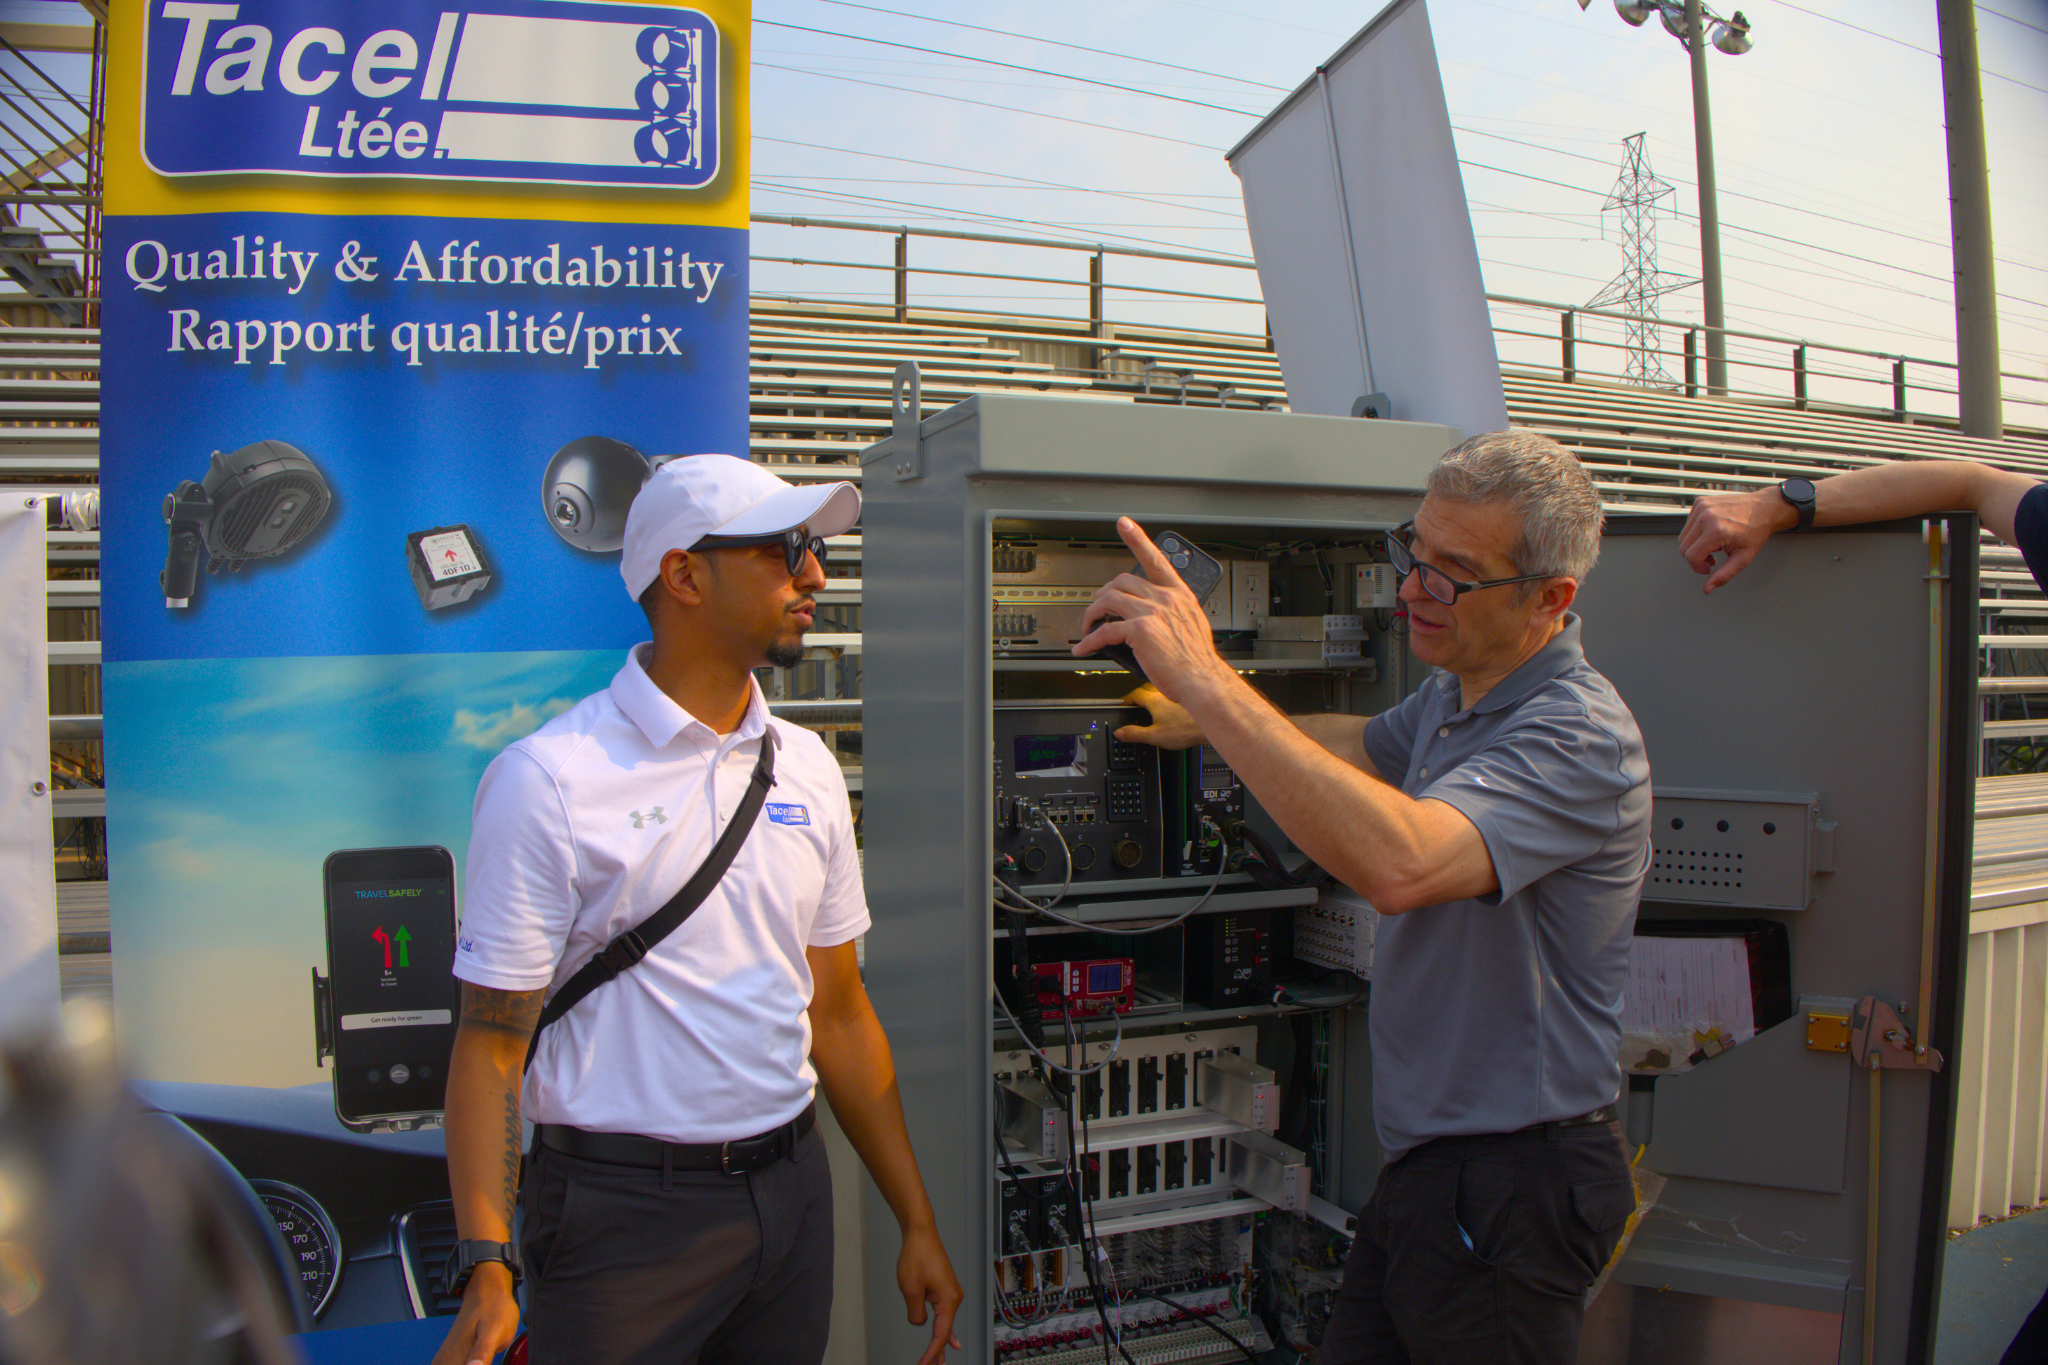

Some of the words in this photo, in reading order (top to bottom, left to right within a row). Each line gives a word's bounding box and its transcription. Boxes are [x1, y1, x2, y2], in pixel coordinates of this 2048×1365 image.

[161, 1, 459, 100] Tacel
[298, 105, 444, 159] Ltée.
[125, 235, 319, 295] Quality
[334, 240, 379, 282] &
[394, 240, 724, 303] Affordability
[167, 309, 375, 365] Rapport
[391, 310, 682, 369] qualité/prix
[443, 564, 471, 576] 4DF1D
[1203, 790, 1218, 798] EDI
[355, 889, 422, 899] TRAVELSAFELY
[278, 1222, 294, 1231] 150
[292, 1234, 308, 1244] 170
[301, 1251, 316, 1261] 190
[302, 1271, 318, 1281] 210
